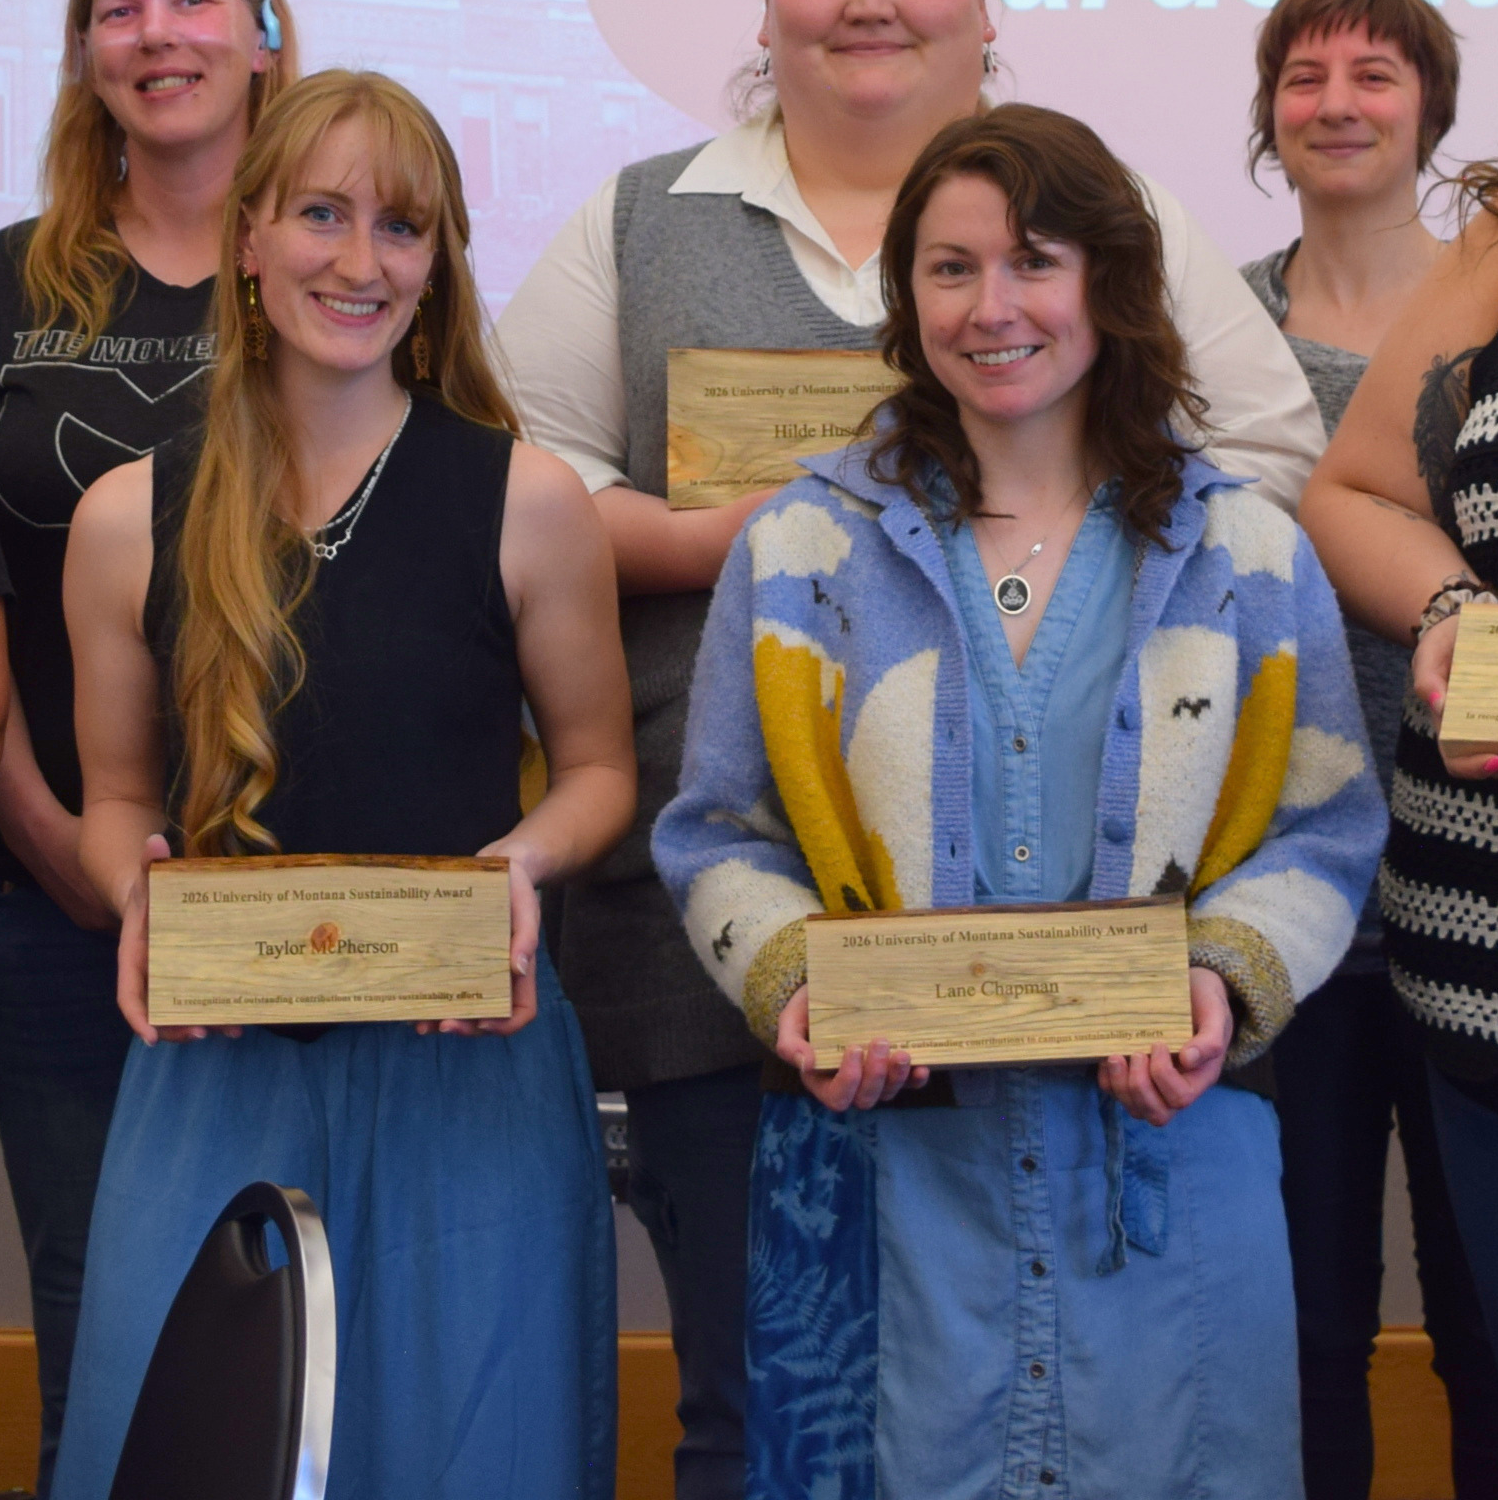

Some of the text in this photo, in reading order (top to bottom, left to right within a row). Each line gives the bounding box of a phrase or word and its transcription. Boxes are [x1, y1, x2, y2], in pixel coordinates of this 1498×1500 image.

[89, 332, 219, 363] MOVE
[704, 387, 728, 397] 2026
[731, 386, 785, 398] University
[788, 385, 800, 395] of
[803, 384, 849, 394] Montana
[774, 423, 816, 438] Hilde
[182, 886, 473, 904] 2026 University of Montana Sustainability Award
[843, 923, 1148, 947] 2026 University of Montana Sustainability Award
[255, 939, 399, 959] Taylor McPherson
[935, 980, 1059, 999] Lane Chapman
